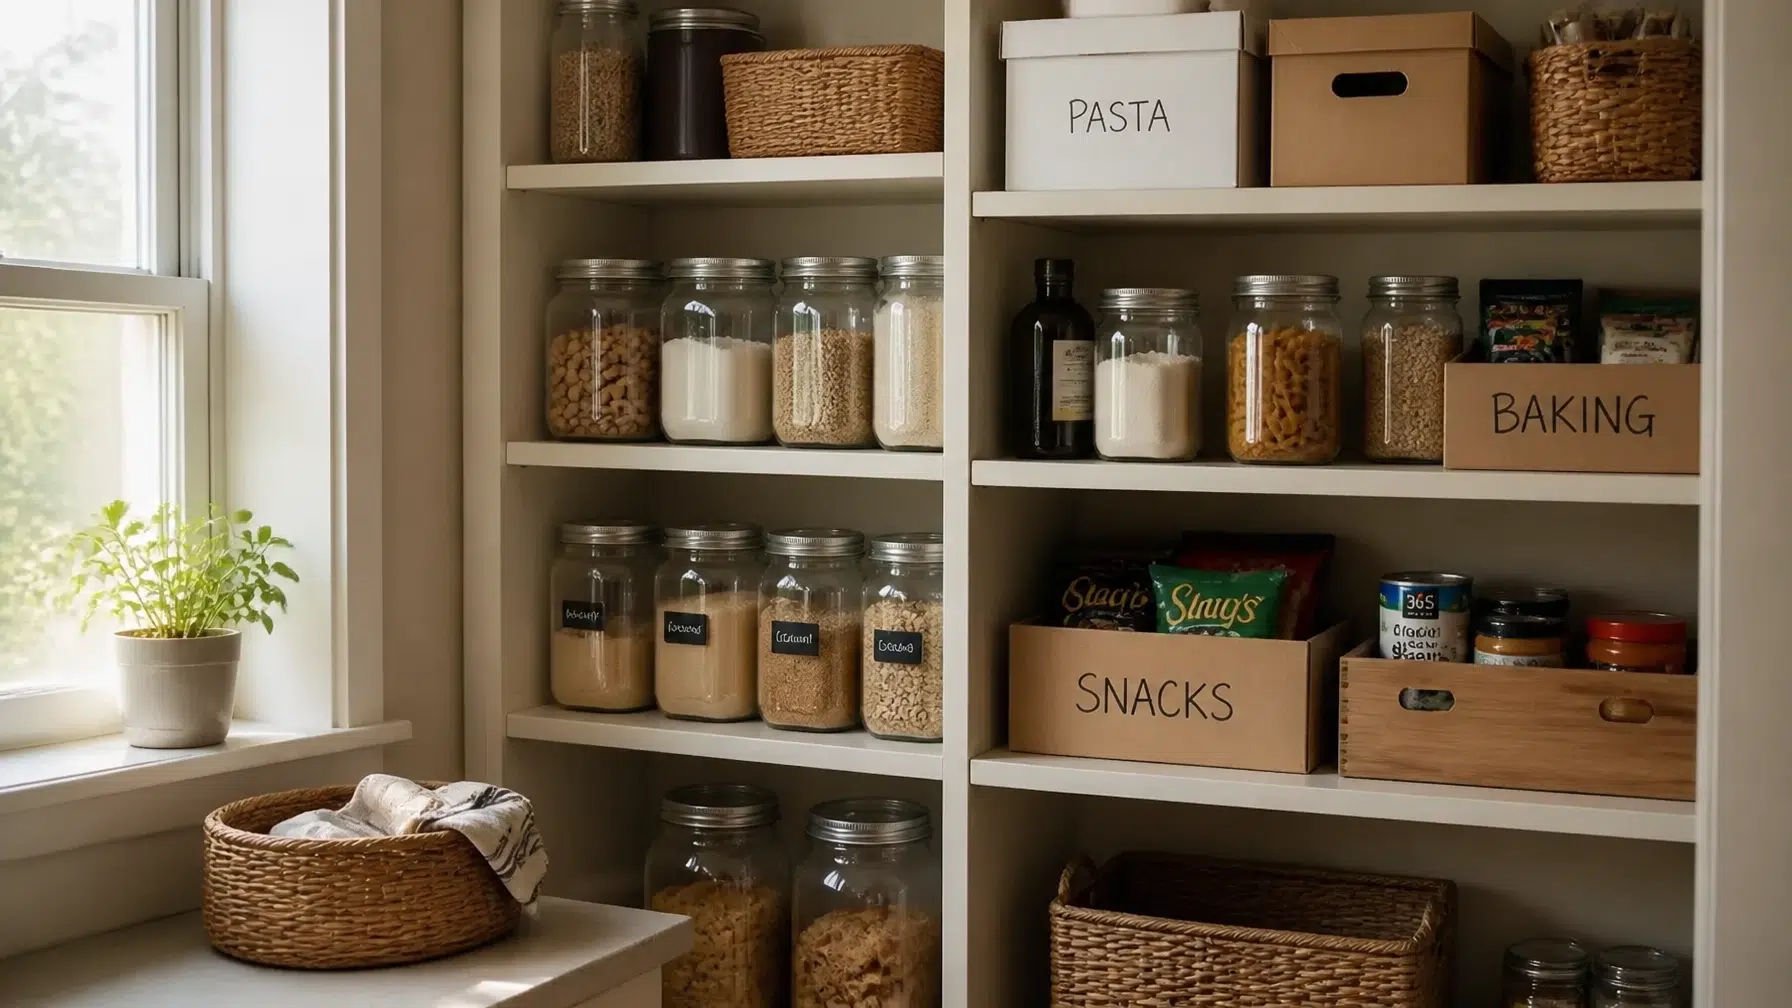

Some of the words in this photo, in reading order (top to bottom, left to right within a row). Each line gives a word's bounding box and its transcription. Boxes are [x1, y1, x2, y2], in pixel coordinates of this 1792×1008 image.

[1069, 98, 1171, 134] PASTA
[1491, 392, 1656, 438] BAKING
[1075, 672, 1234, 722] SNACKS
